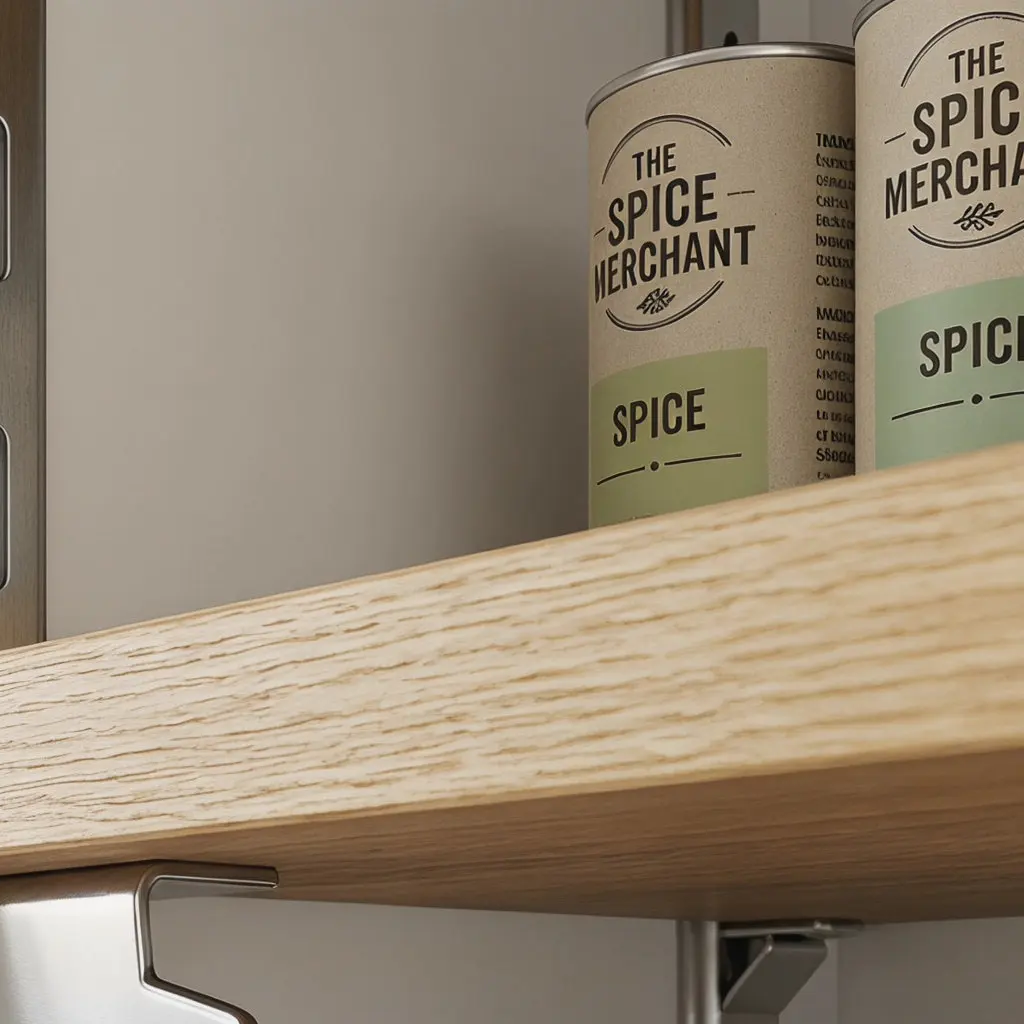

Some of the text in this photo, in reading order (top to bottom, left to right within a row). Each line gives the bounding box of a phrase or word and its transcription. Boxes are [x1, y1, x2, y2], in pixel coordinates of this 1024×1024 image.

[948, 41, 1005, 83] THE
[913, 81, 1020, 155] SPIC
[632, 143, 677, 181] THE
[608, 172, 718, 247] SPICE
[613, 388, 706, 447] SPICE
